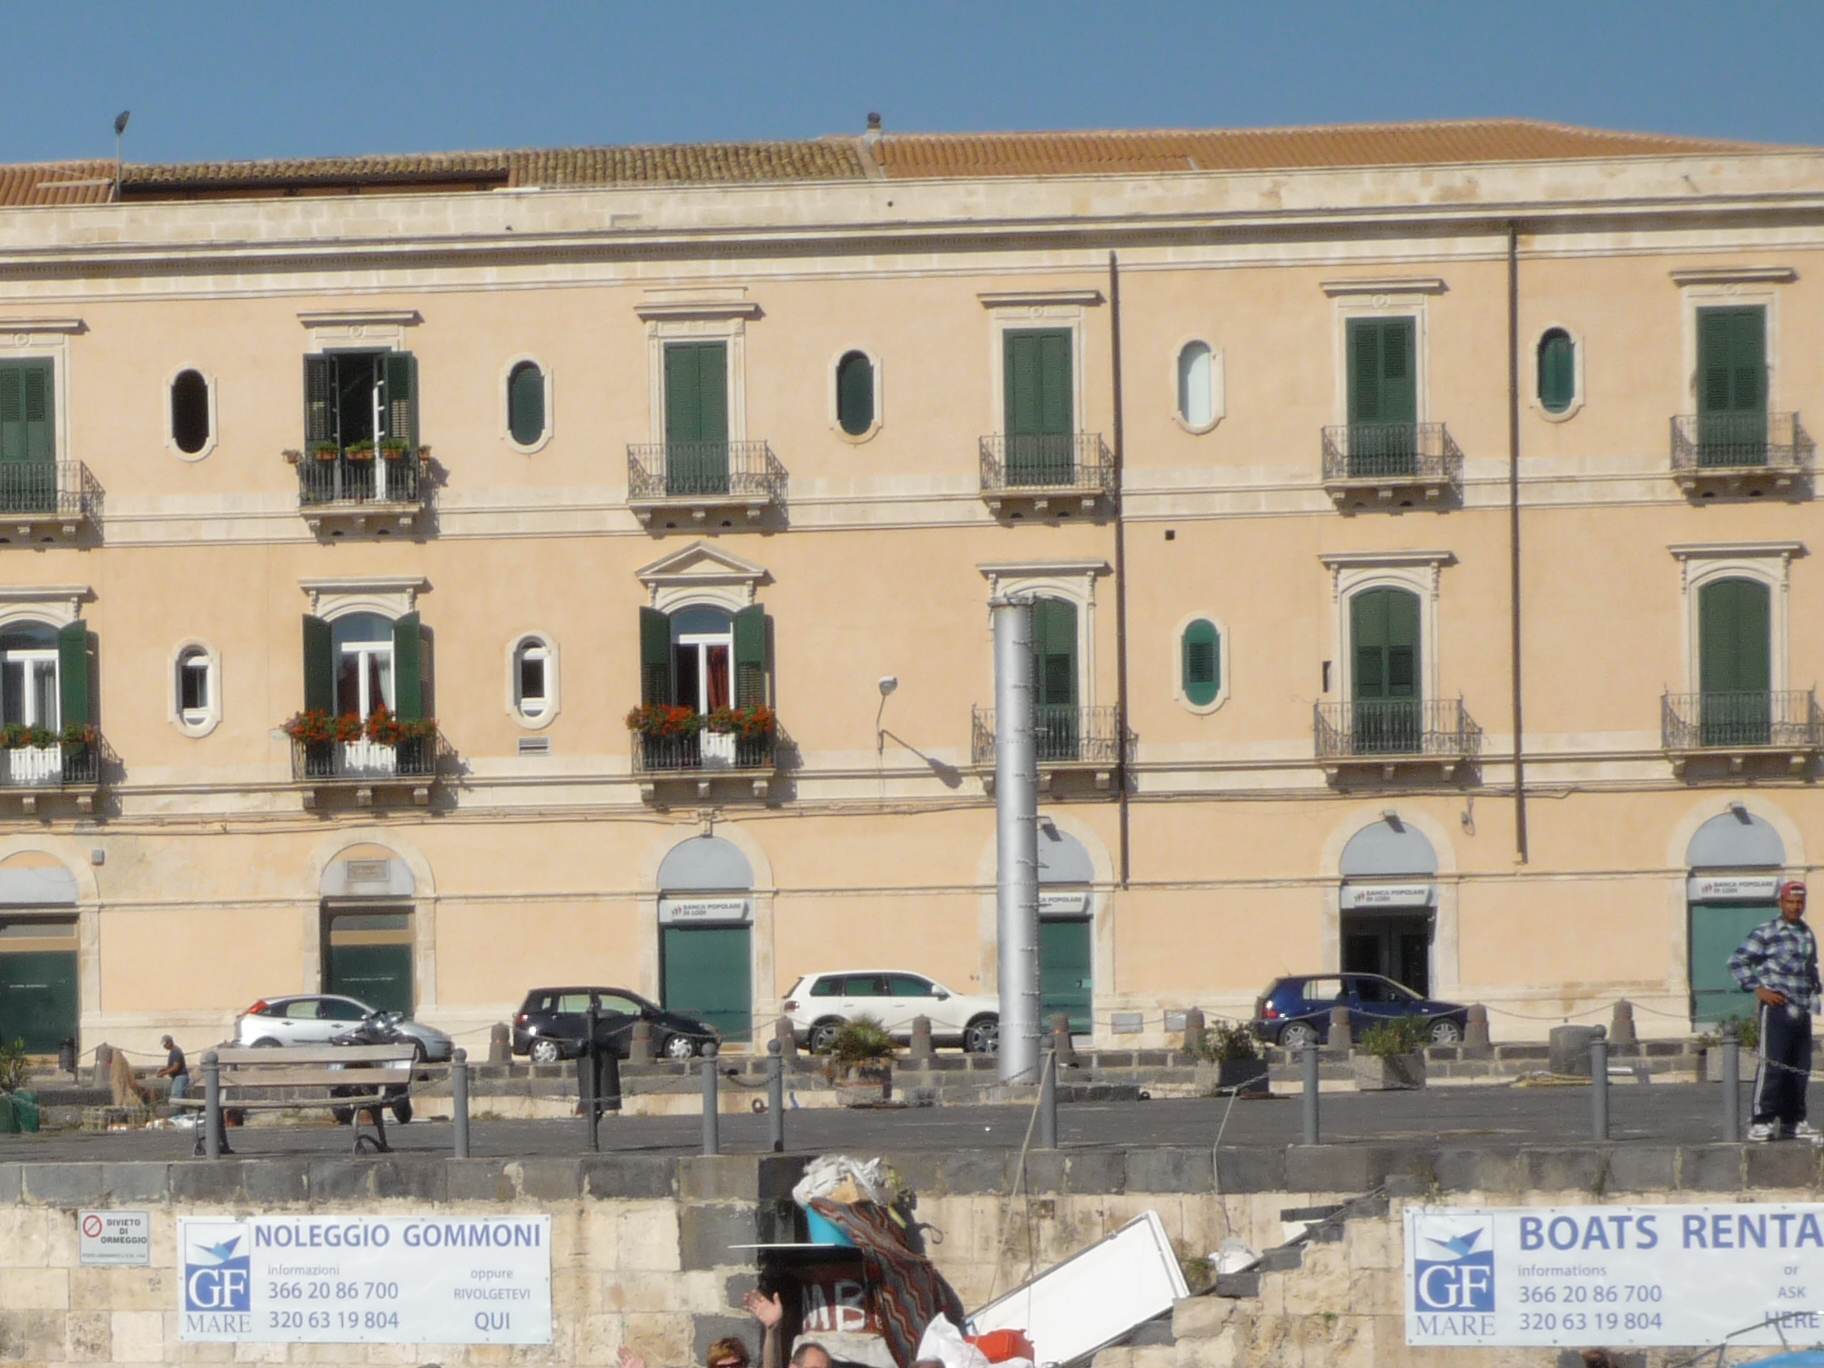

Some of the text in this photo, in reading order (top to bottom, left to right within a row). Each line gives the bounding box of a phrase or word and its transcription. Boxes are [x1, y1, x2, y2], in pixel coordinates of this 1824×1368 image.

[100, 1236, 148, 1244] ORMEGGIO
[255, 1223, 541, 1248] NOLEGGIO GOMMONI
[1519, 1213, 1824, 1250] BOATS RENTA
[267, 1264, 340, 1276] informazioni
[470, 1269, 514, 1282] oppure
[1518, 1264, 1607, 1277] informations
[1784, 1265, 1799, 1276] or
[188, 1268, 247, 1309] GF
[268, 1281, 399, 1299] 366 20 86 700
[454, 1288, 531, 1300] RIVOLGETEVI
[1418, 1264, 1491, 1309] GF
[1519, 1284, 1662, 1303] 366 20 86 700
[1777, 1286, 1807, 1299] ASK
[186, 1313, 252, 1334] MARE
[269, 1311, 399, 1329] 320 63 19 804
[474, 1311, 510, 1332] QUI
[1415, 1314, 1497, 1337] MARE
[1519, 1312, 1663, 1331] 320 63 19 804
[1765, 1310, 1820, 1329] HERE
